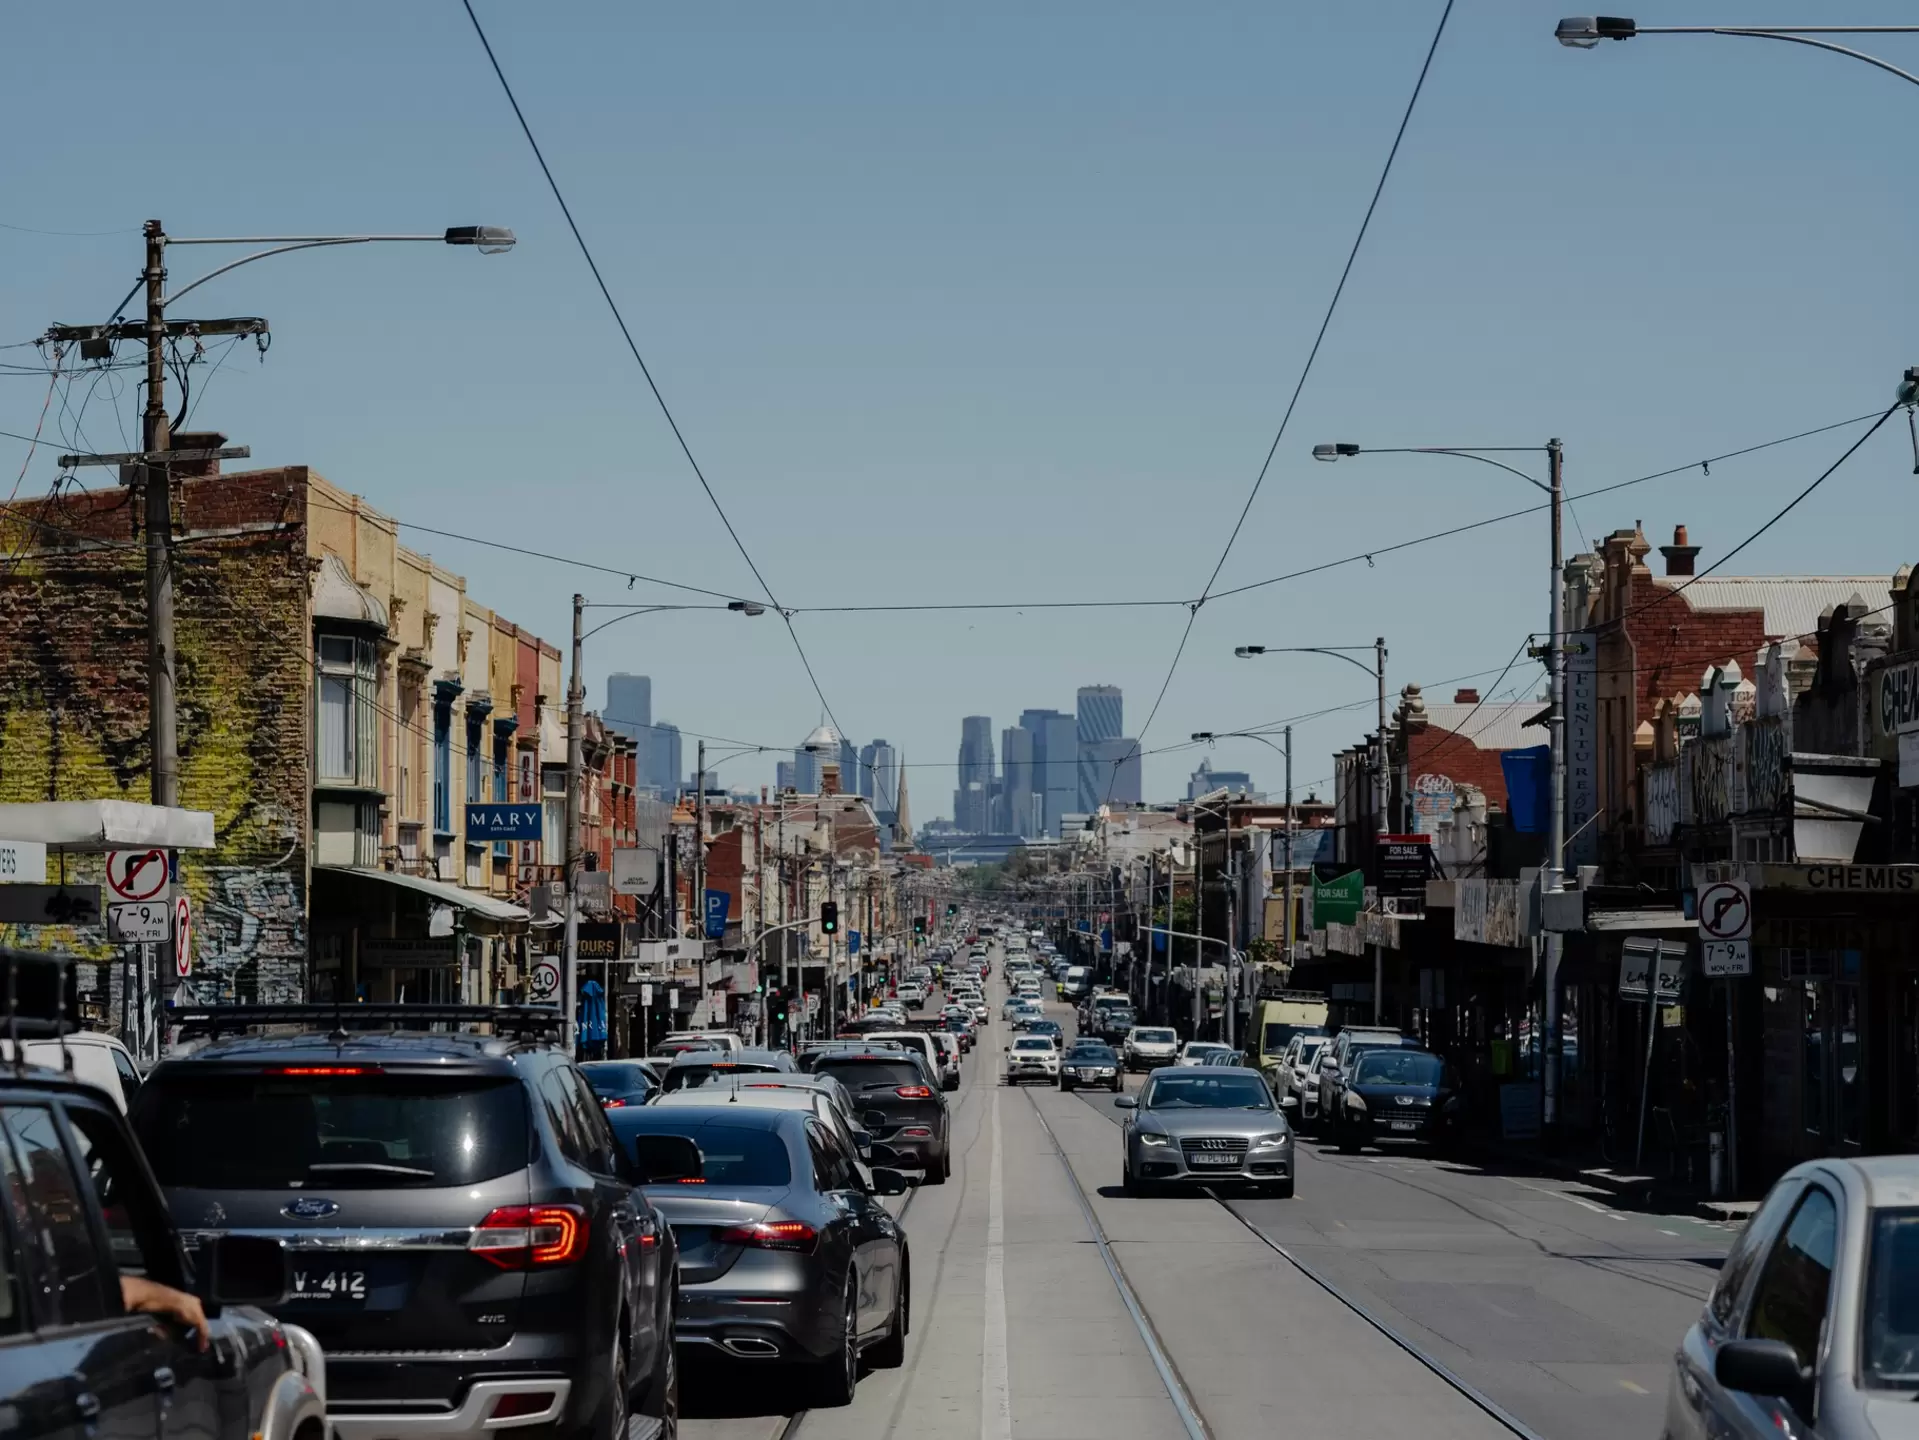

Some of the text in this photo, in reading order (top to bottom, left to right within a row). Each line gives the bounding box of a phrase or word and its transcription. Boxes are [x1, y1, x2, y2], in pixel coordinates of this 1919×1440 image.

[1573, 672, 1590, 790] FURNITURE
[471, 812, 536, 826] MARY
[1389, 846, 1418, 854] FOR SALE
[1807, 867, 1919, 888] CHEMIS
[1317, 888, 1348, 898] FOR SALE
[709, 897, 721, 912] P
[152, 917, 164, 925] AM
[534, 972, 554, 986] 40
[295, 1200, 326, 1213] Ford
